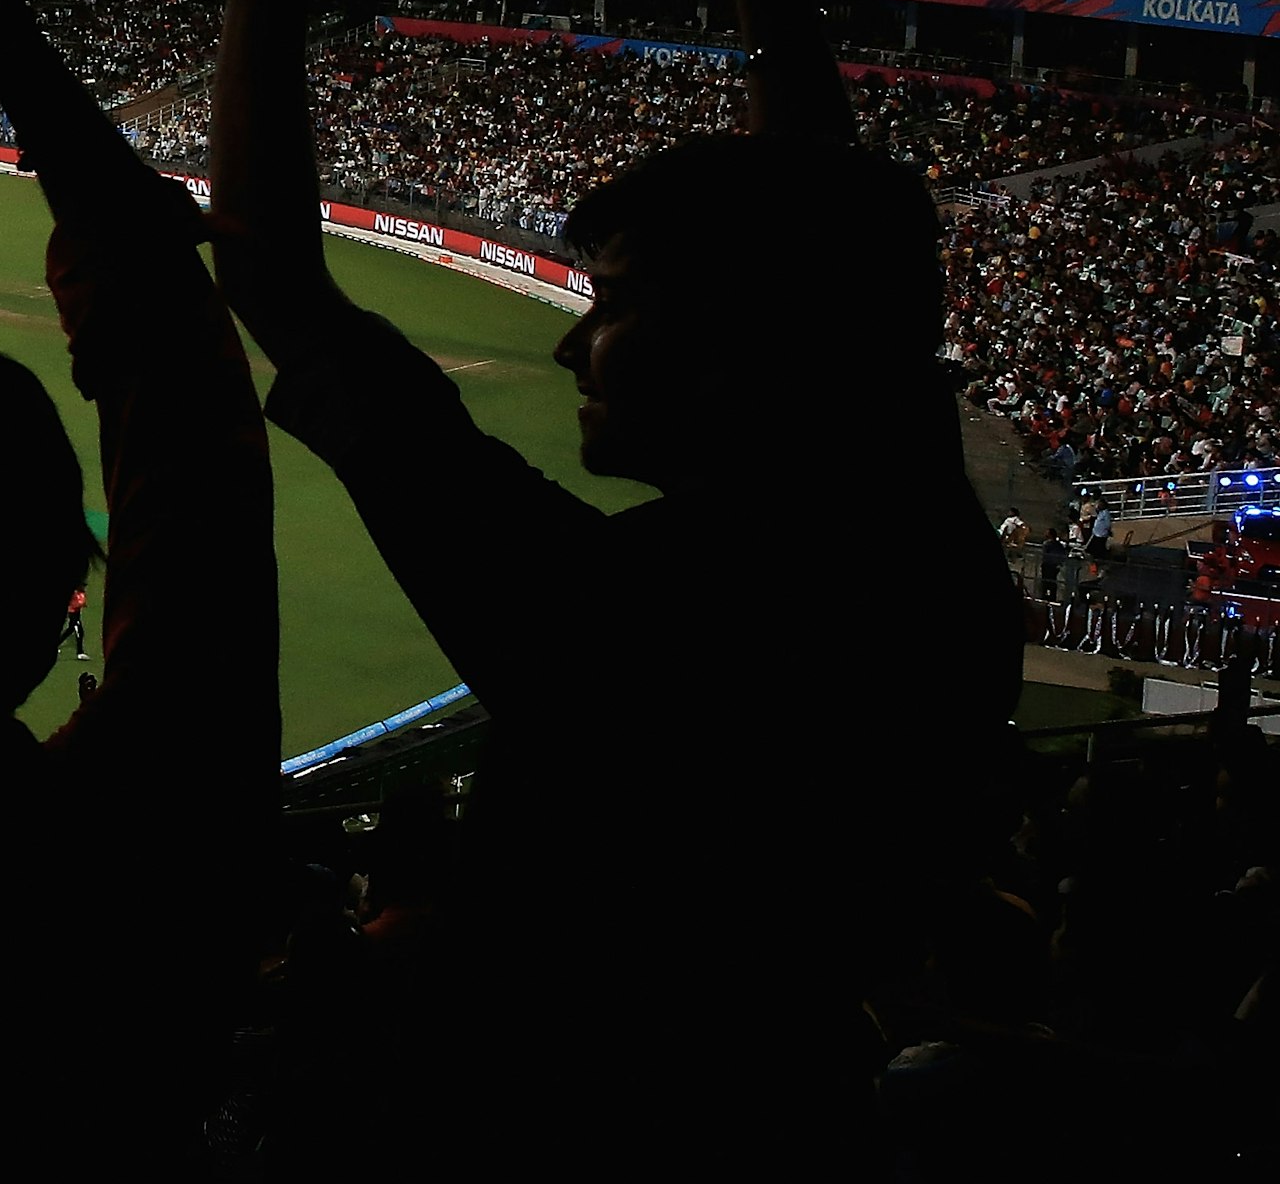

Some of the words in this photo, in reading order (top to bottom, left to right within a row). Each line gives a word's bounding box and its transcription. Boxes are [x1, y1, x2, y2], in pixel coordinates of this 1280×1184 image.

[374, 214, 444, 246] NISSAN
[480, 240, 535, 275] NISSAN
[566, 270, 595, 297] NIS
